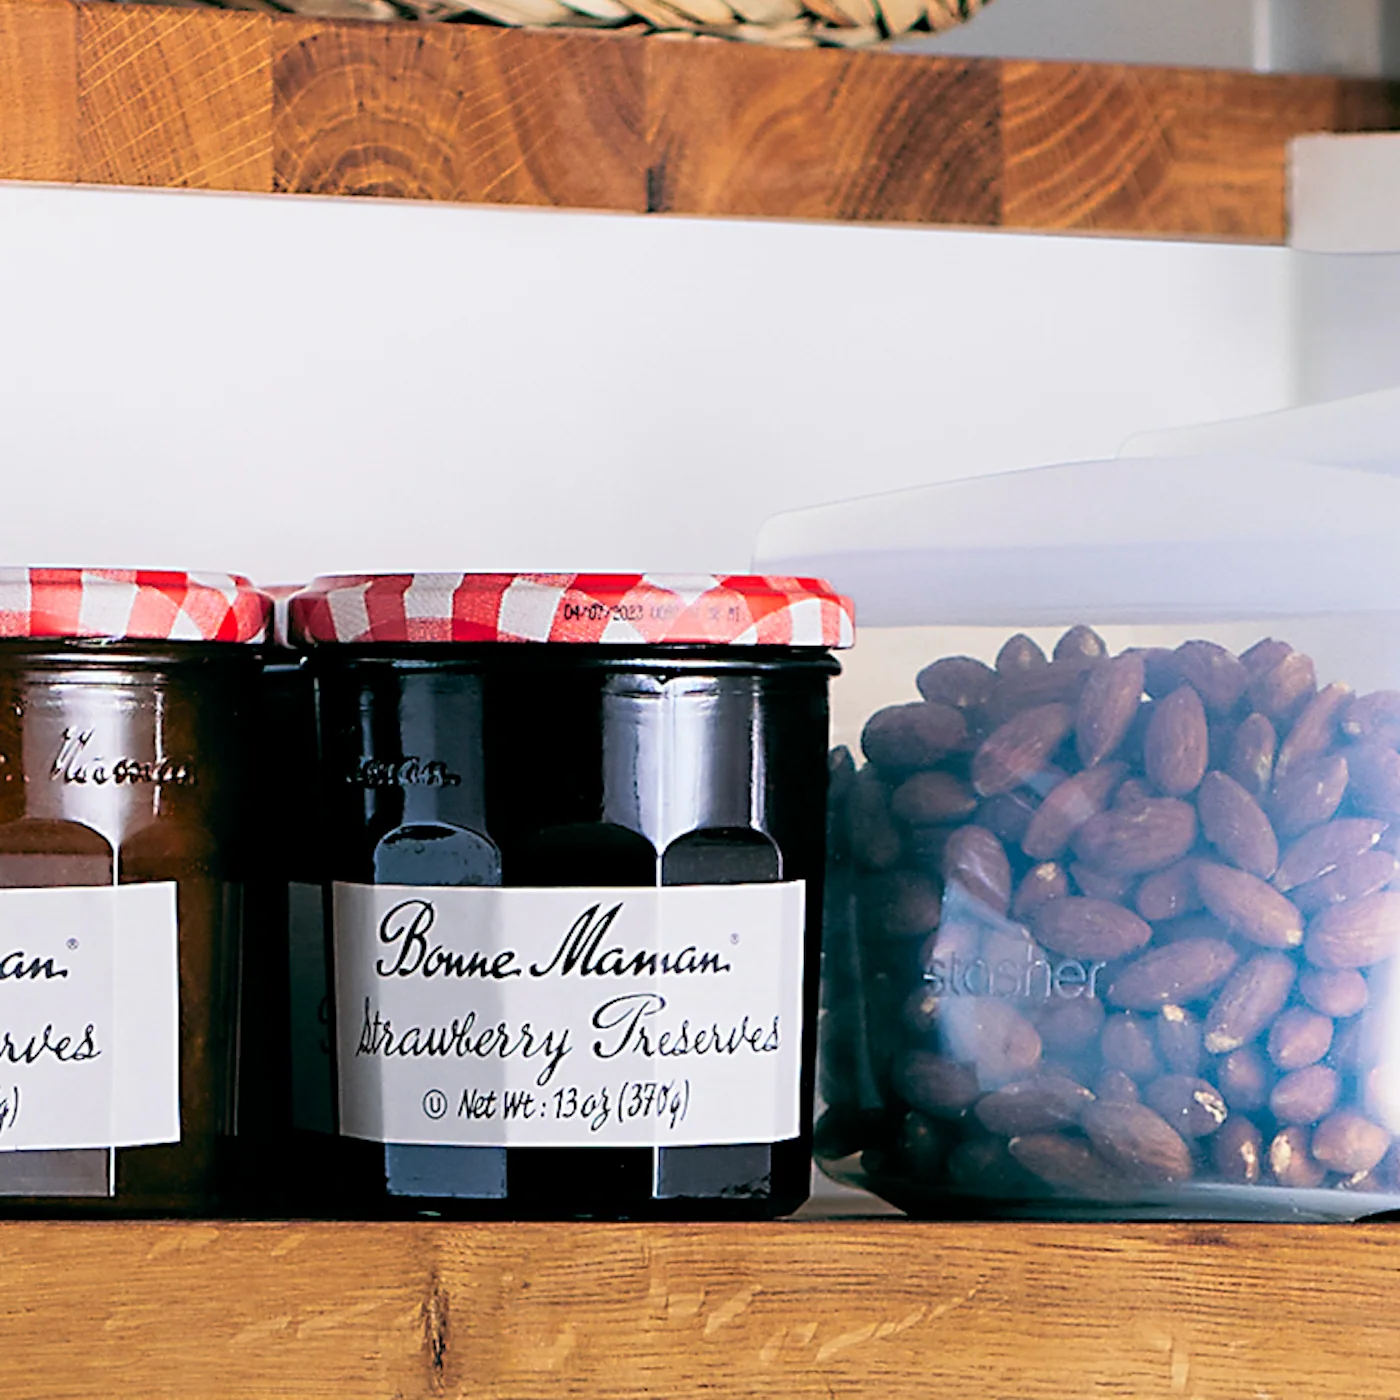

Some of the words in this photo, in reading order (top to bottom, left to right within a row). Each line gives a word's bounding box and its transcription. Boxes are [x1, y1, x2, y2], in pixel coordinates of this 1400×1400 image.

[376, 899, 522, 979] Bonne
[530, 902, 731, 977] Maman
[923, 944, 1107, 999] stasher
[355, 996, 573, 1086] Strawberry
[592, 992, 780, 1059] Preserves
[457, 1088, 498, 1120] Net
[617, 1079, 690, 1130] (370g)
